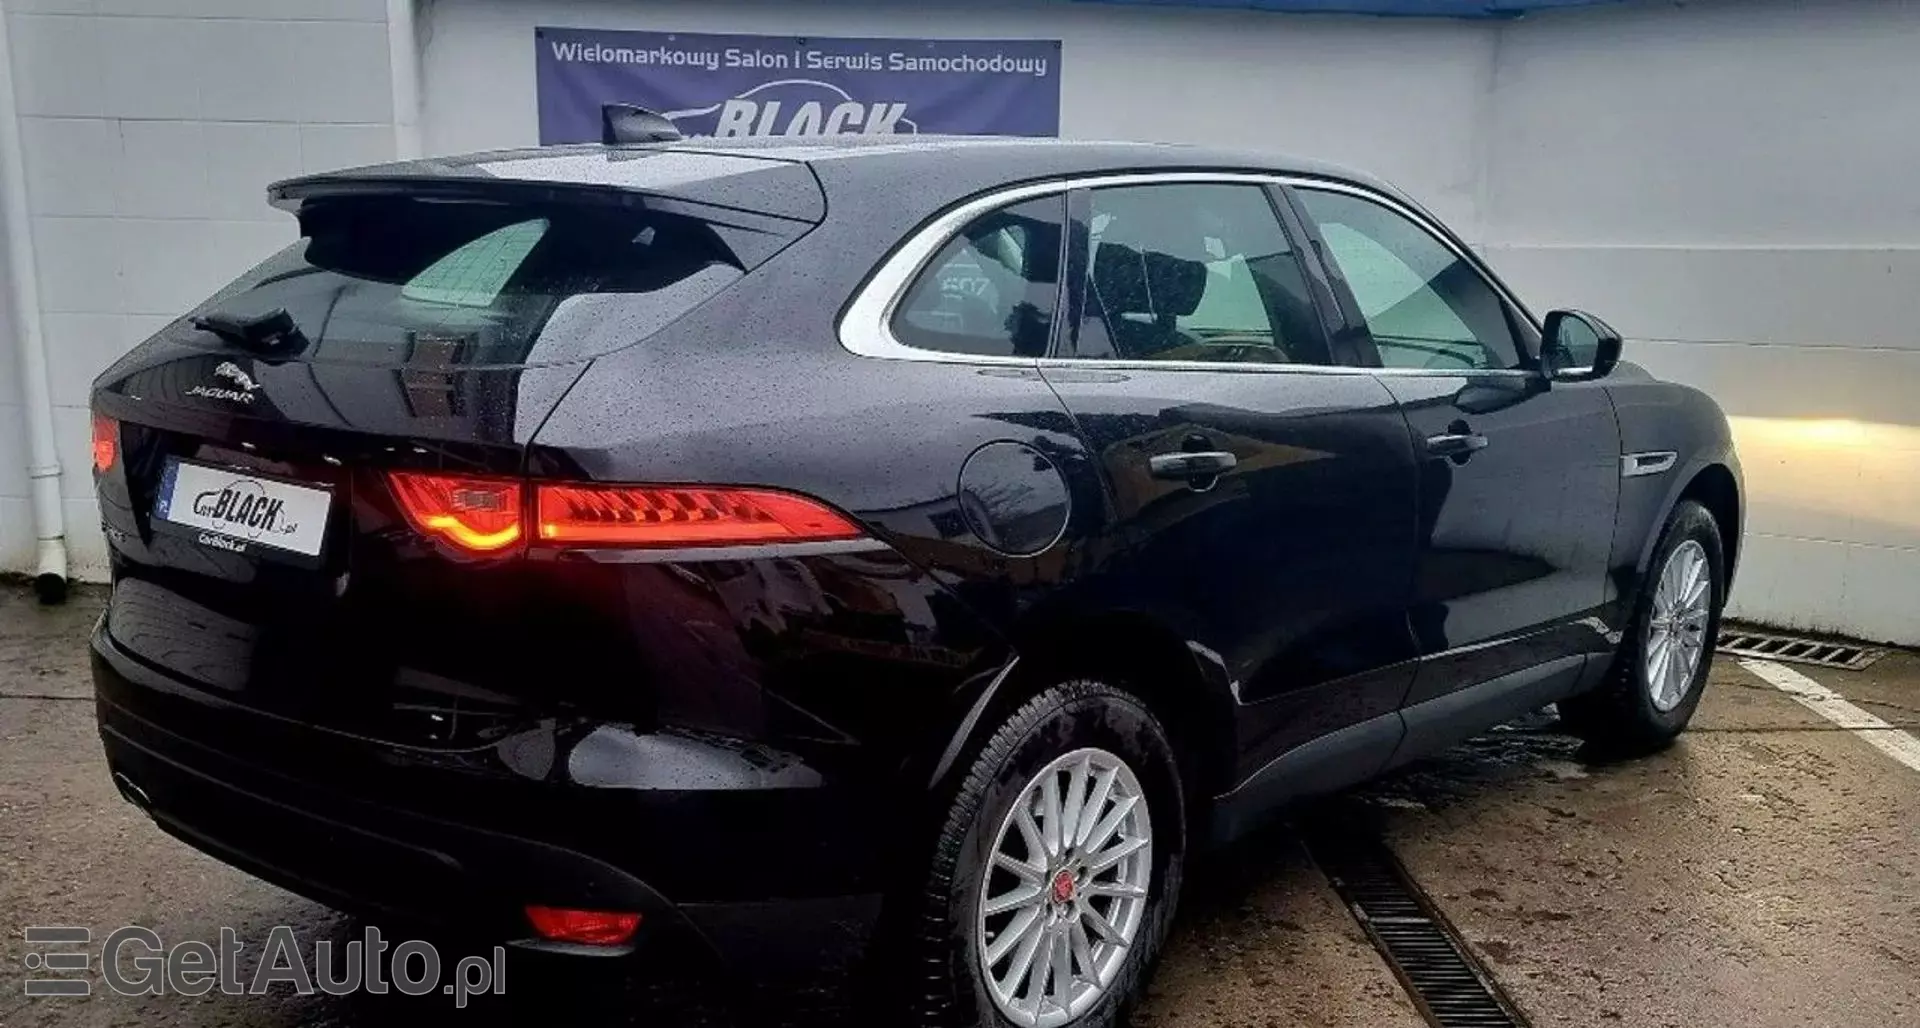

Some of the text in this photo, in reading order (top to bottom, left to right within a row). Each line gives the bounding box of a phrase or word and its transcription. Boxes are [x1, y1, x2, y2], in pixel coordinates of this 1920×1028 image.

[551, 41, 719, 71] Wielomarkowy
[725, 48, 789, 69] Salon
[806, 51, 882, 71] Serwis
[888, 52, 1047, 76] Samochodowy
[714, 99, 908, 137] BLACK
[184, 385, 254, 404] JAGUAR
